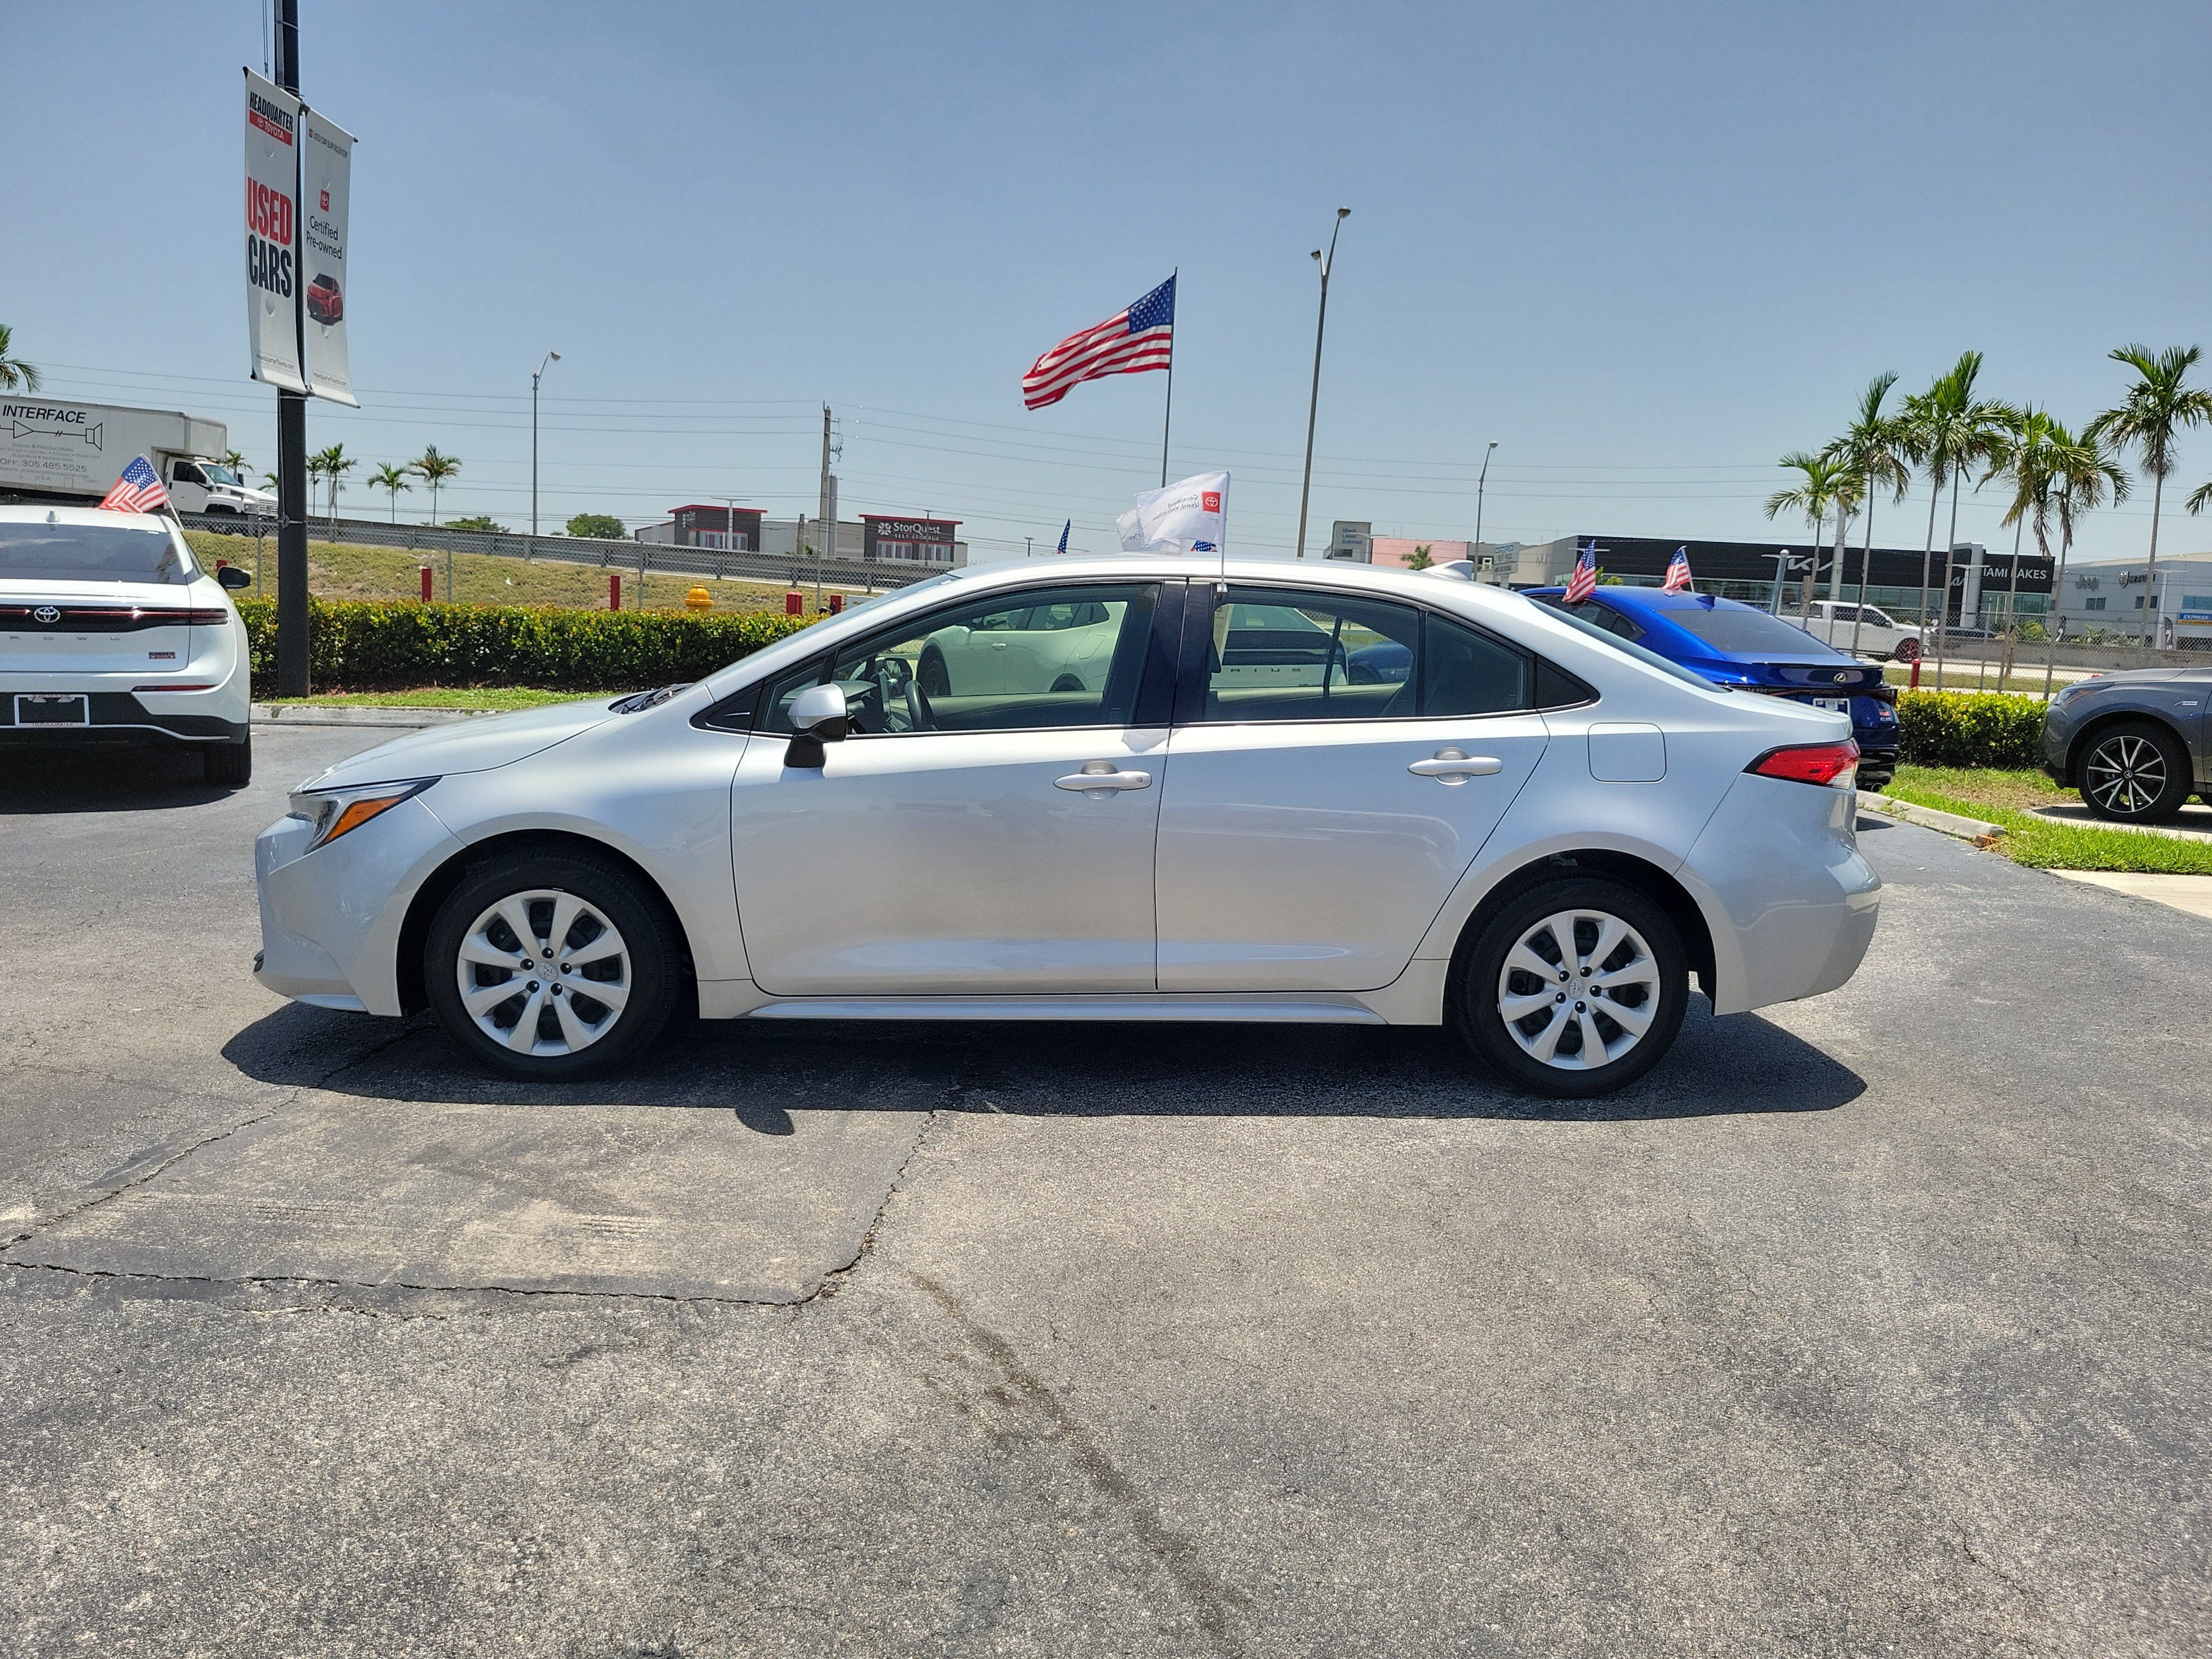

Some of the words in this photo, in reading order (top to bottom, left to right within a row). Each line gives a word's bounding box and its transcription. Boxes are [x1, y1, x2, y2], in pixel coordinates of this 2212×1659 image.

[250, 91, 294, 132] HEADQUARTER
[264, 121, 285, 140] TOYOTA
[248, 176, 292, 245] USED
[310, 216, 338, 241] Certified
[307, 231, 342, 259] Pre-owned
[249, 234, 292, 298] CARS
[3, 405, 87, 424] INTERFACE
[893, 522, 940, 535] StorQuest
[1983, 567, 2008, 578] IAMI
[2012, 569, 2047, 580] AKES
